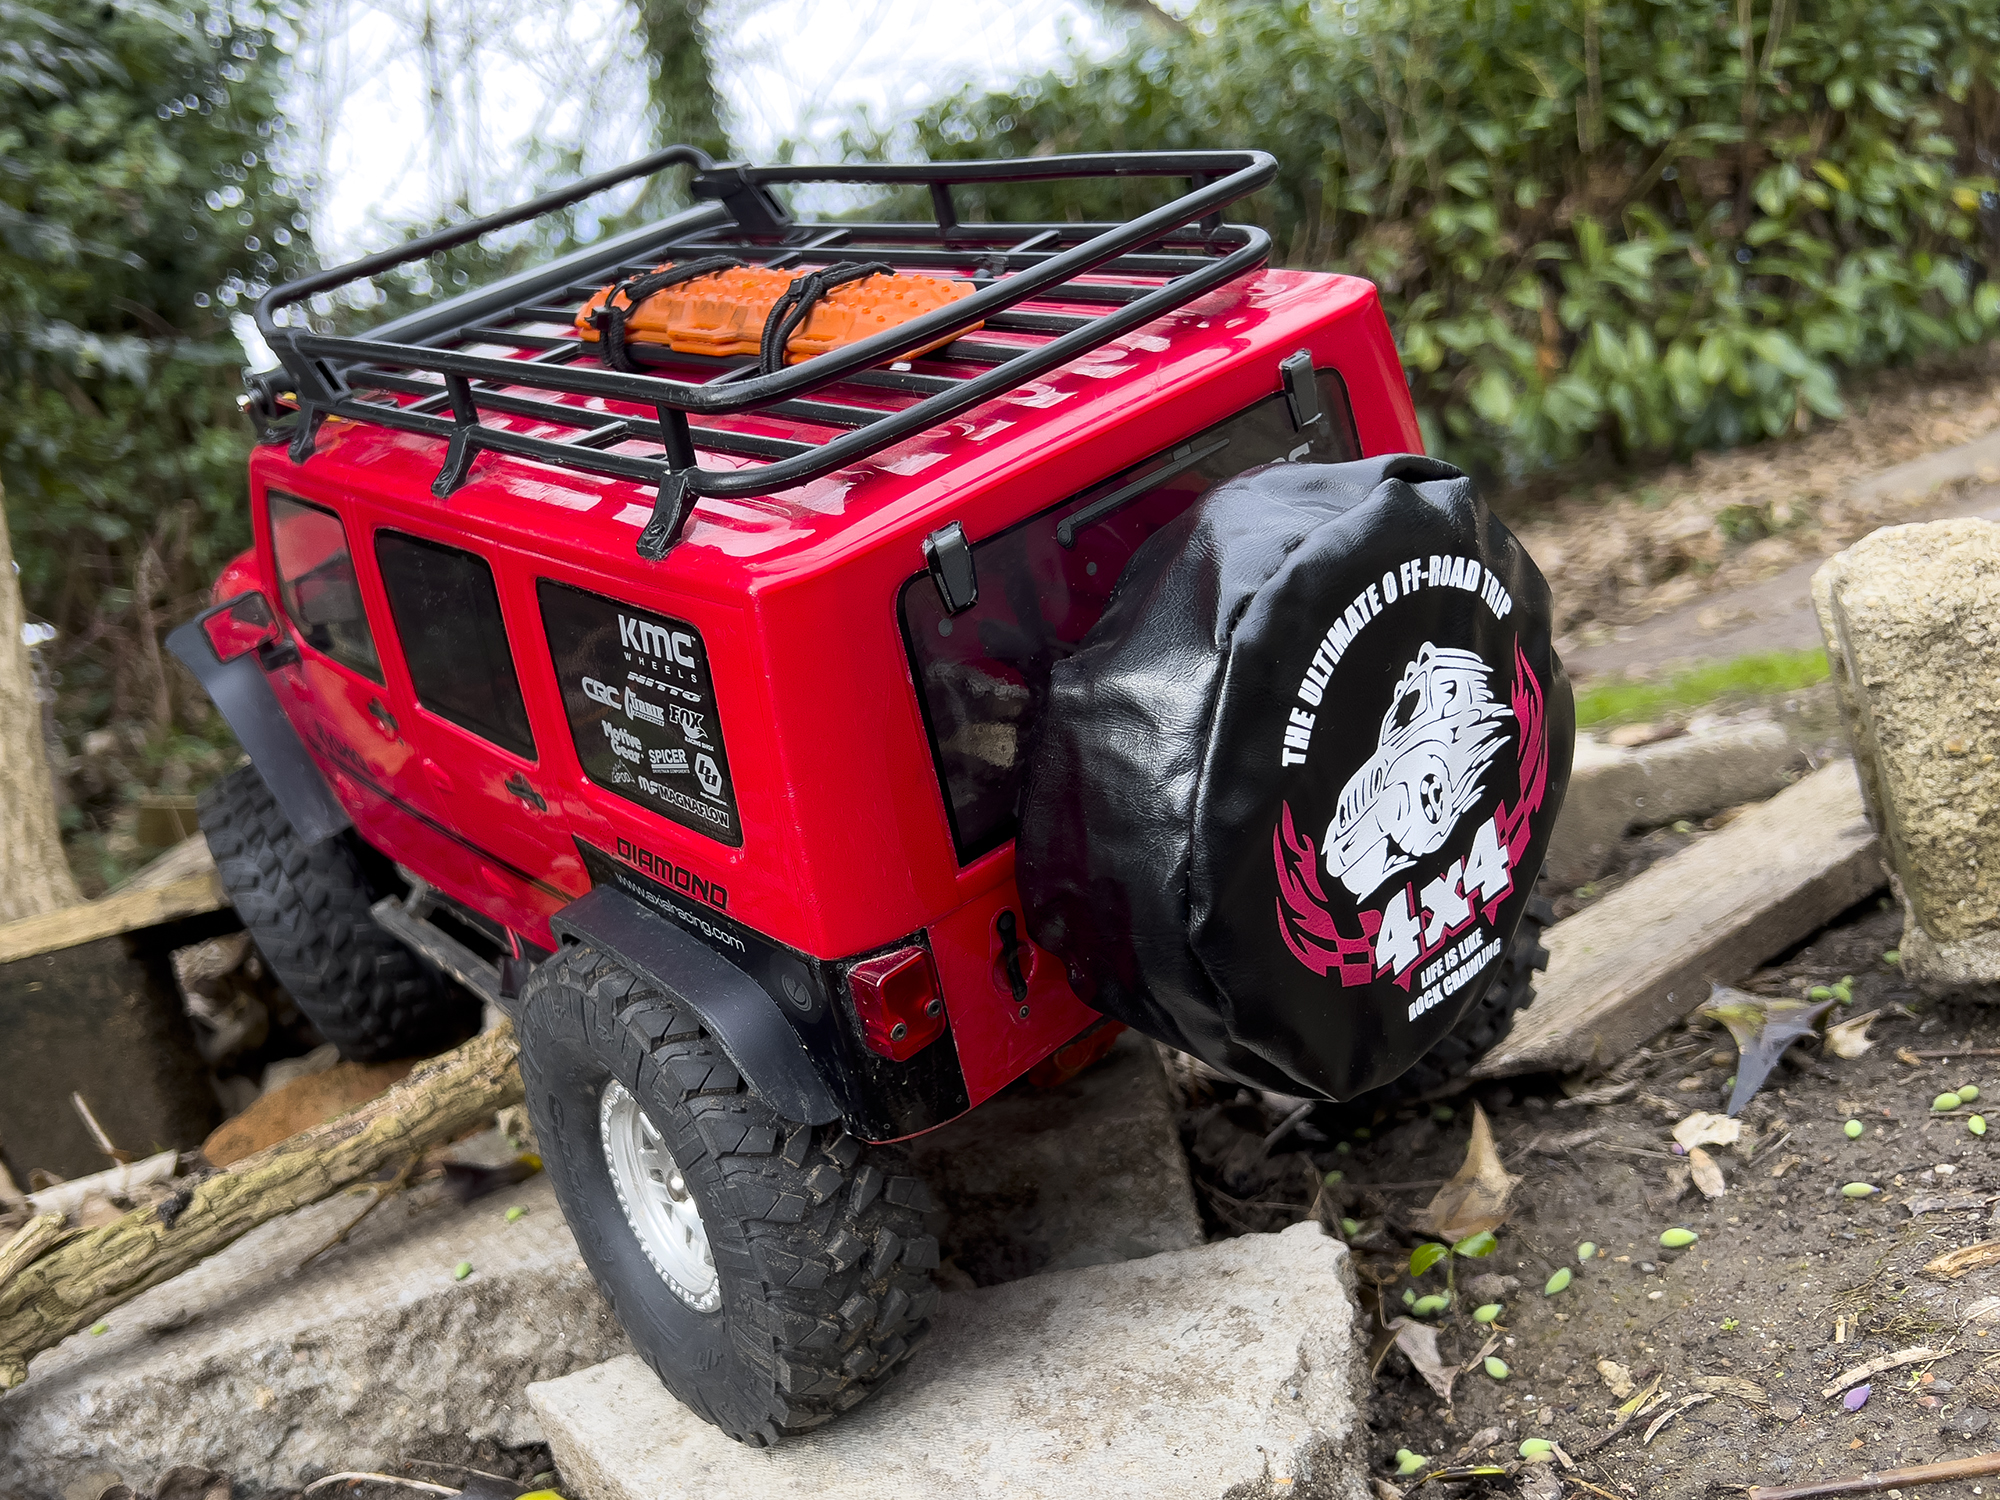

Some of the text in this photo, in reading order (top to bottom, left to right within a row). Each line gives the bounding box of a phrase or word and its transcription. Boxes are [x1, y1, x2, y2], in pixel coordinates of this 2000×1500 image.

[1480, 568, 1513, 620] TRIP
[618, 614, 696, 669] KMC
[624, 652, 698, 683] WHEELS
[1297, 583, 1383, 707] ULTIMATE
[627, 671, 702, 703] NITTO
[669, 703, 705, 730] FOX
[1281, 707, 1316, 767] THE
[648, 748, 688, 764] SPICER
[658, 784, 730, 829] MAGNAFLOW
[616, 836, 729, 911] DIAMOND
[614, 872, 746, 953] www.axialracing.com
[1408, 936, 1503, 1022] ROCK CRAWLING
[1420, 926, 1485, 990] LIFE IS LIKE
